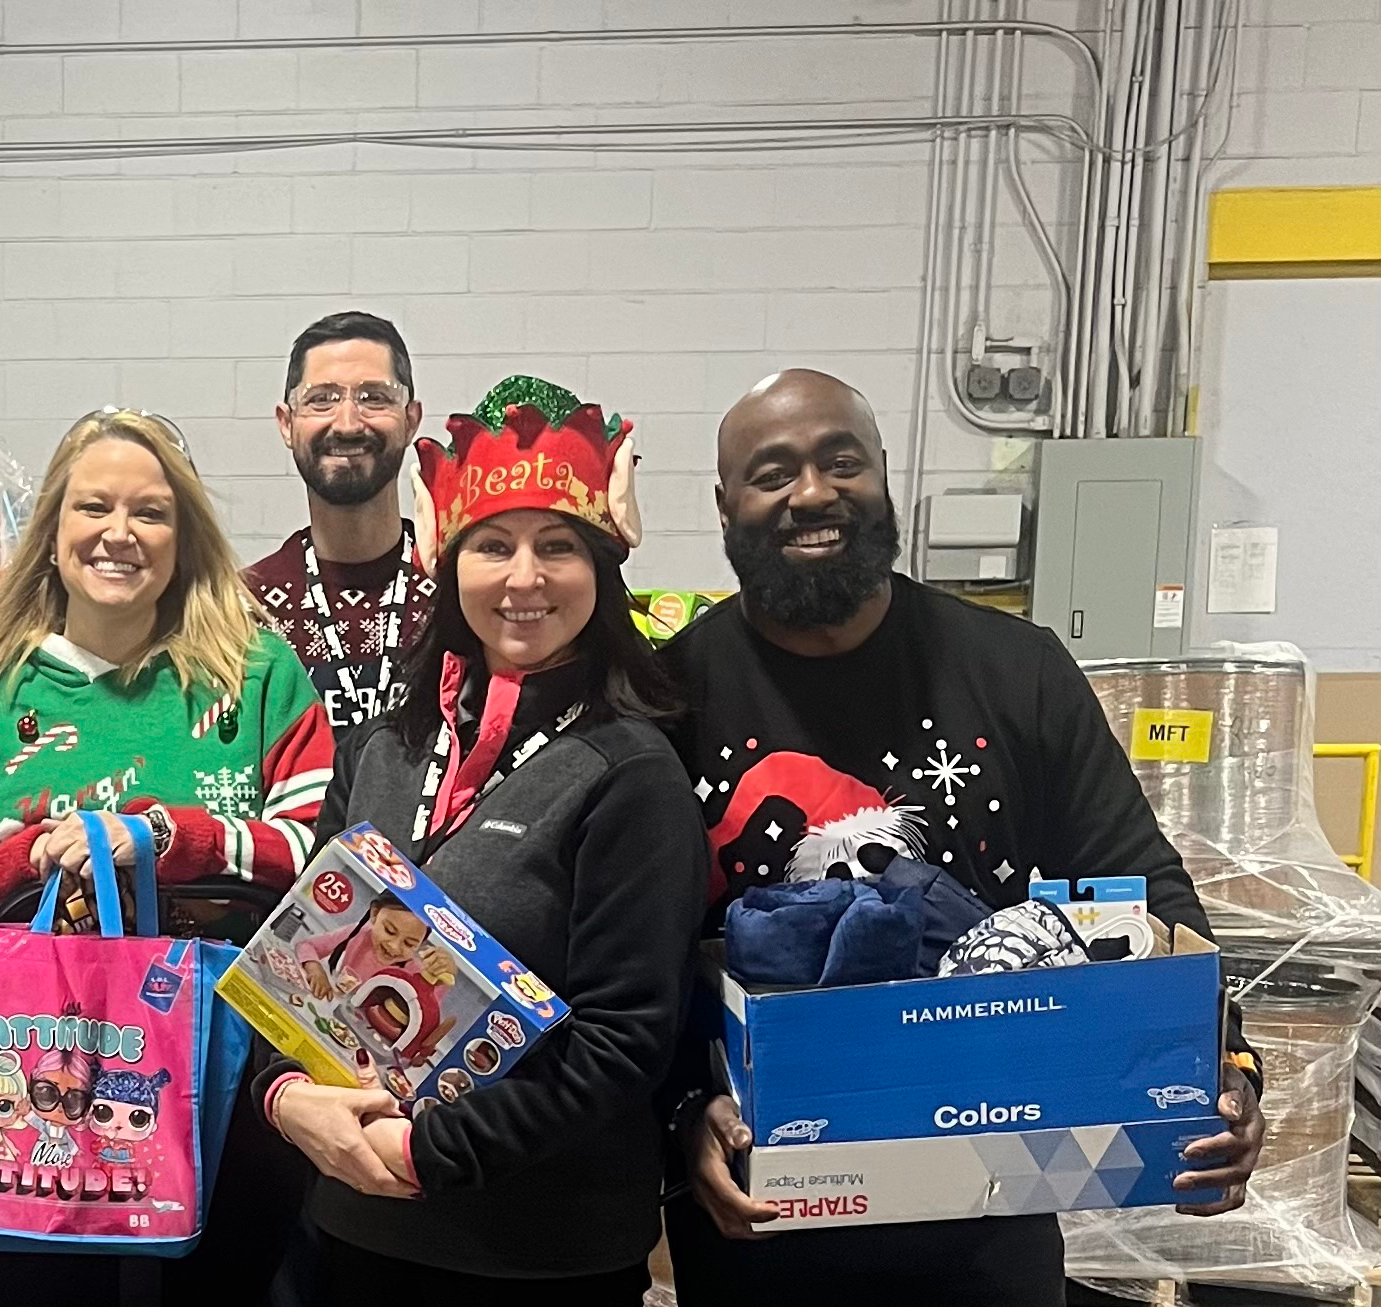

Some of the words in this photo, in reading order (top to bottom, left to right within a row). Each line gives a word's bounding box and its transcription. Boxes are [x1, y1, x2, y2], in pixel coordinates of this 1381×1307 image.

[459, 452, 574, 511] Beata
[1149, 724, 1190, 742] MFT
[318, 873, 349, 903] 25+
[901, 996, 1063, 1025] HAMMERMILL
[933, 1101, 1042, 1130] Colors
[31, 1142, 73, 1168] More
[763, 1175, 805, 1189] Paper
[129, 1214, 150, 1228] BB
